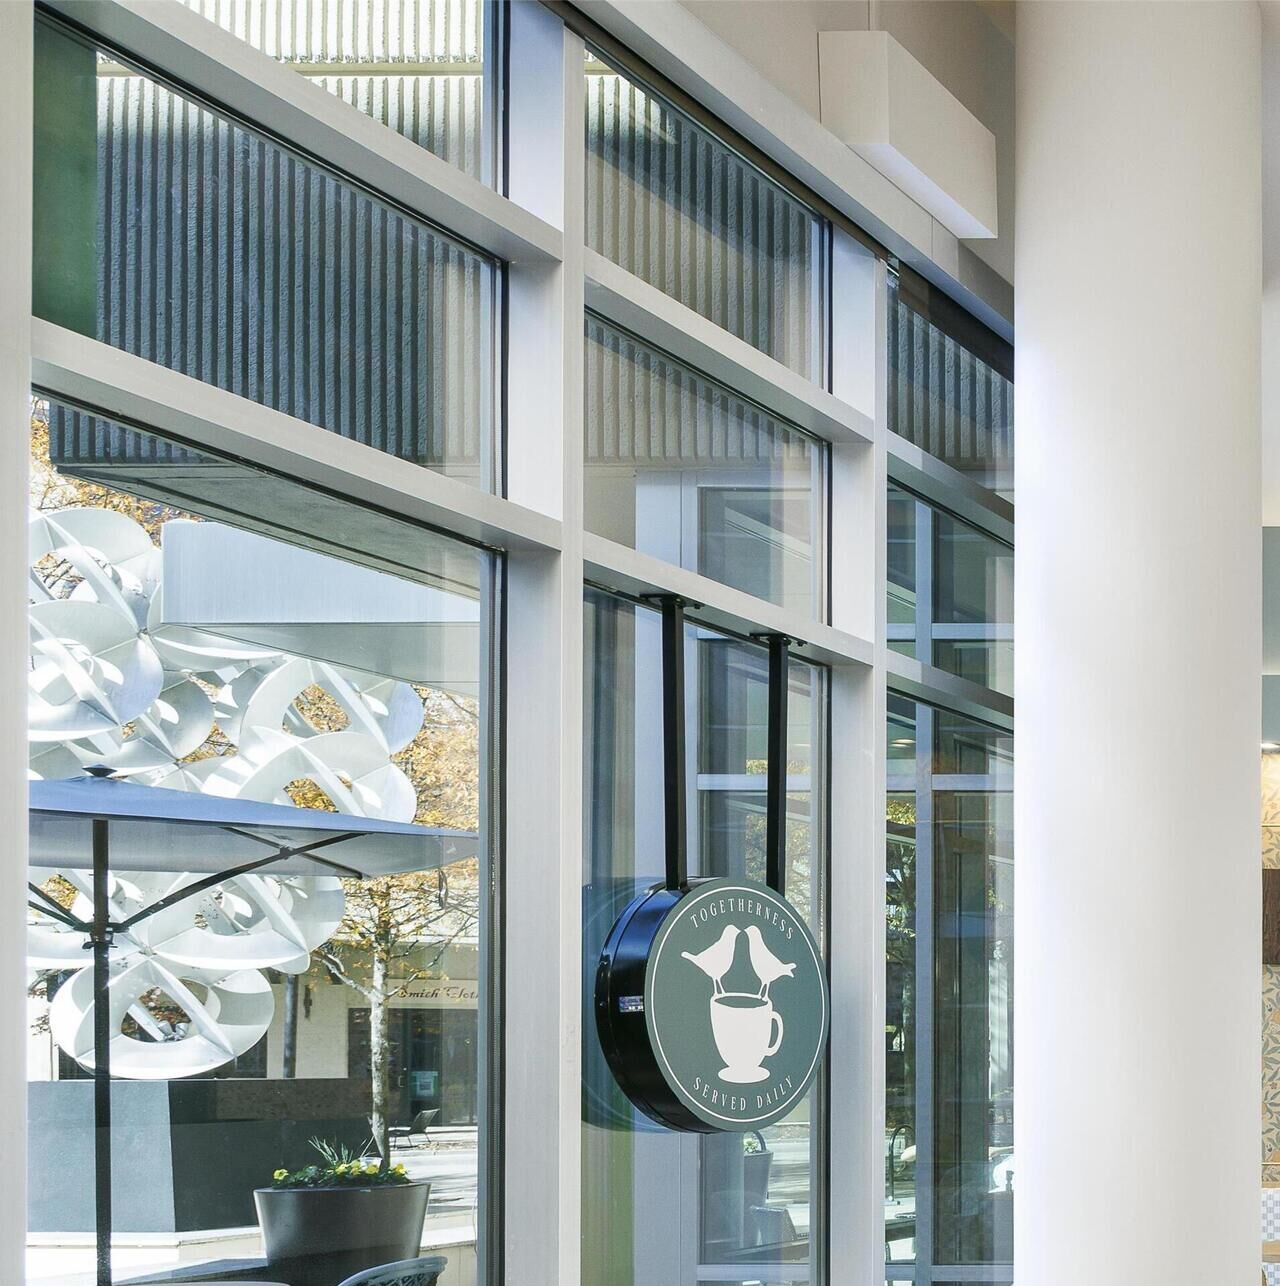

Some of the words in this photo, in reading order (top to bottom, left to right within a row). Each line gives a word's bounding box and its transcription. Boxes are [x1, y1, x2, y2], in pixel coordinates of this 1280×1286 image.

[690, 898, 794, 940] TOGETHERNESS
[693, 1076, 748, 1111] SERVED
[757, 1075, 793, 1109] DAILY
